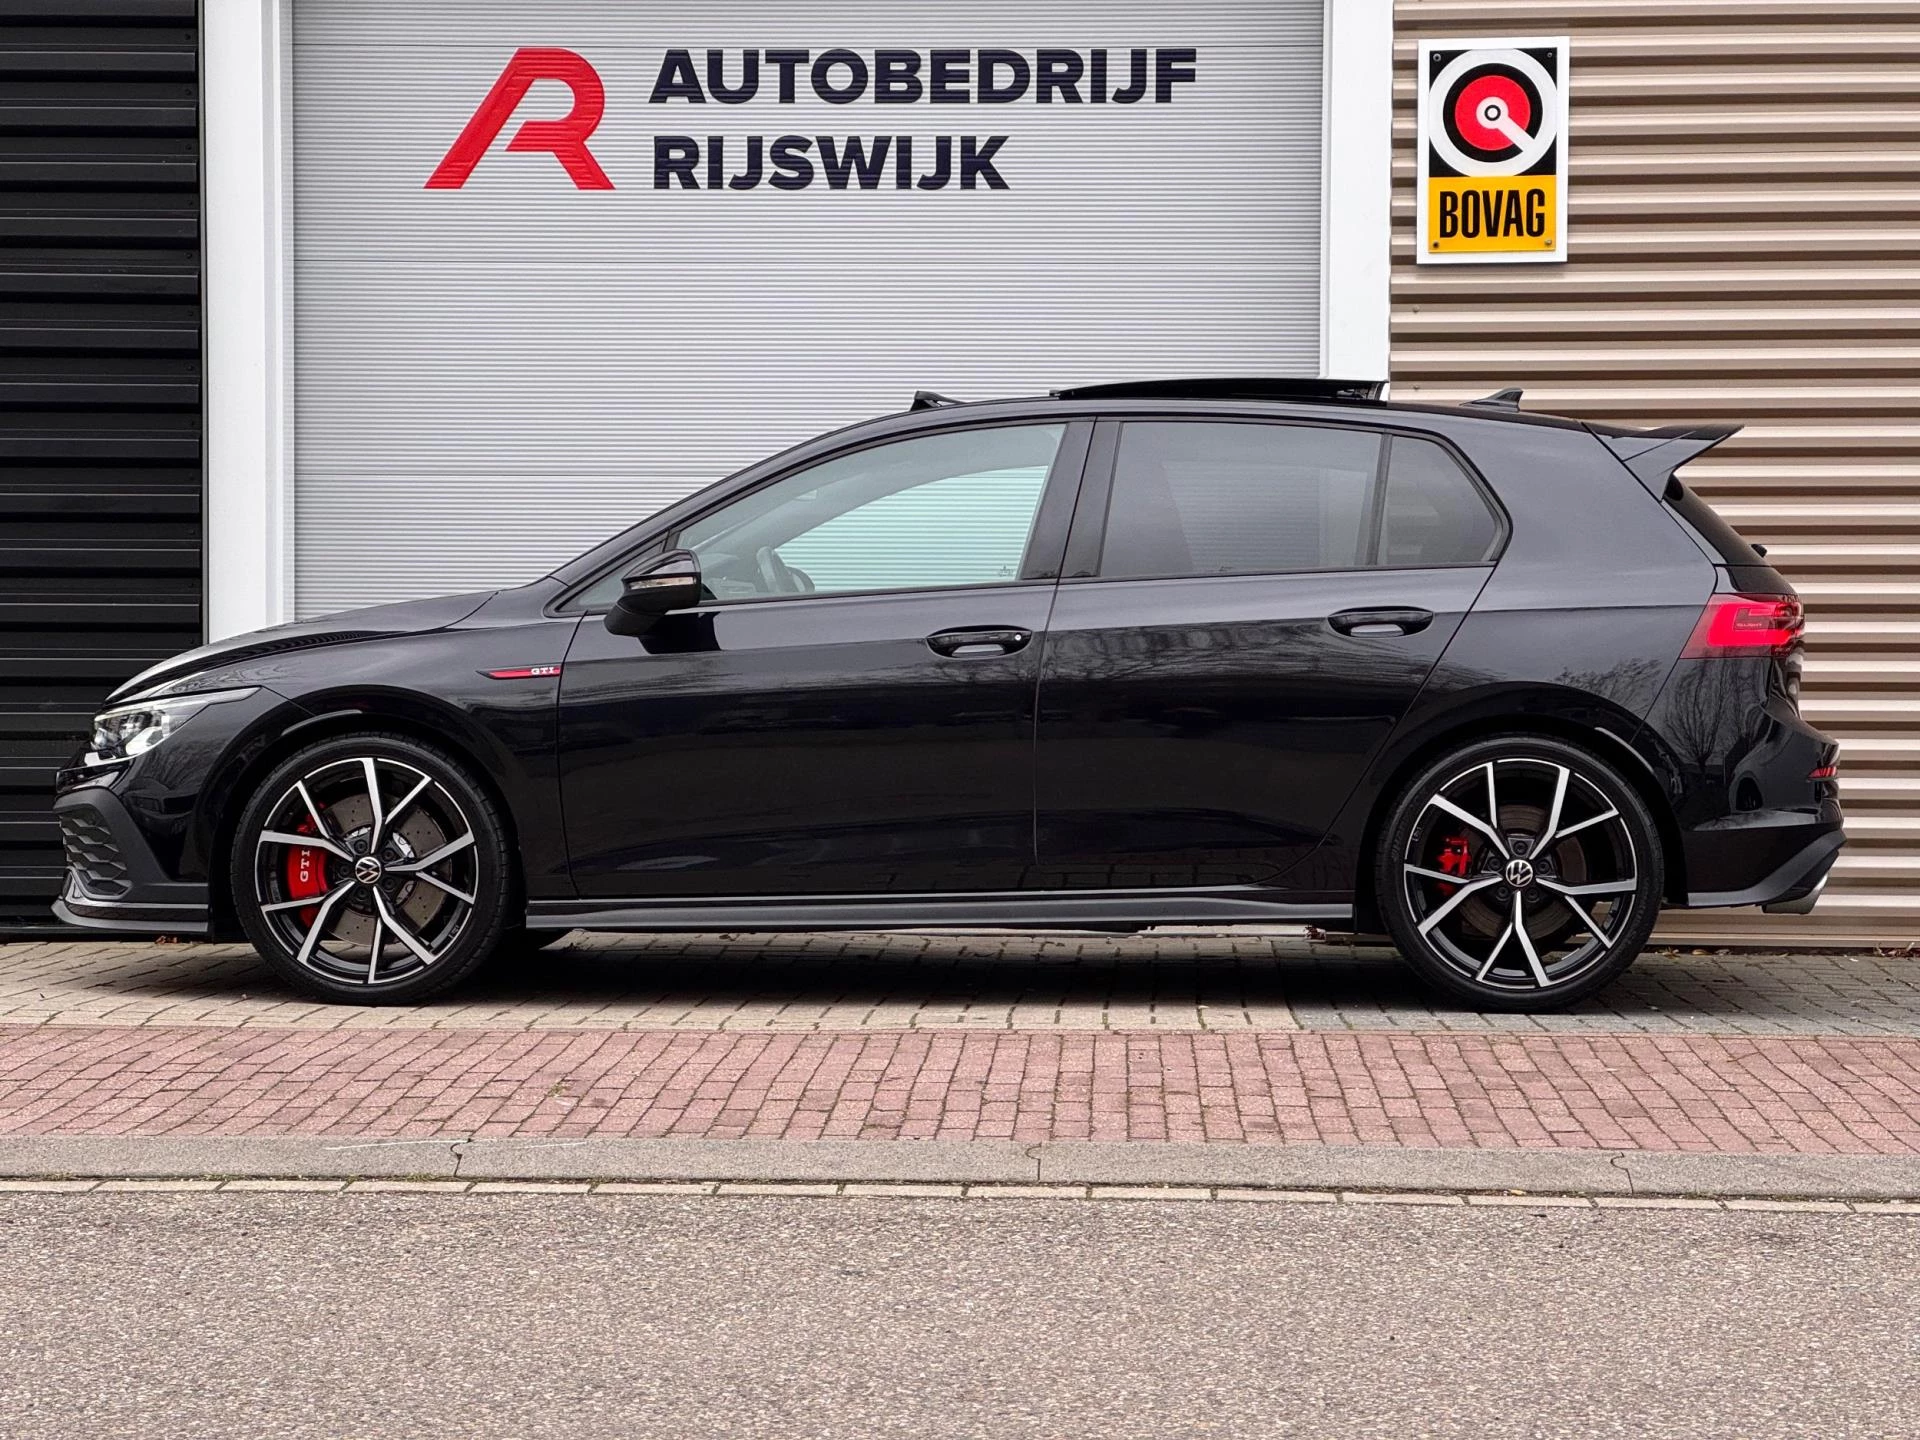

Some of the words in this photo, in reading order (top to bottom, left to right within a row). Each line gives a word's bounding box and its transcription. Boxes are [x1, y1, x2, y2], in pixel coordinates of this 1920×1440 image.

[649, 48, 1197, 104] AUTOBEDRIJF
[653, 135, 1010, 190] RIJSWIJK
[1440, 188, 1546, 238] BOVAG
[531, 667, 554, 675] GTI
[300, 850, 310, 882] GTI
